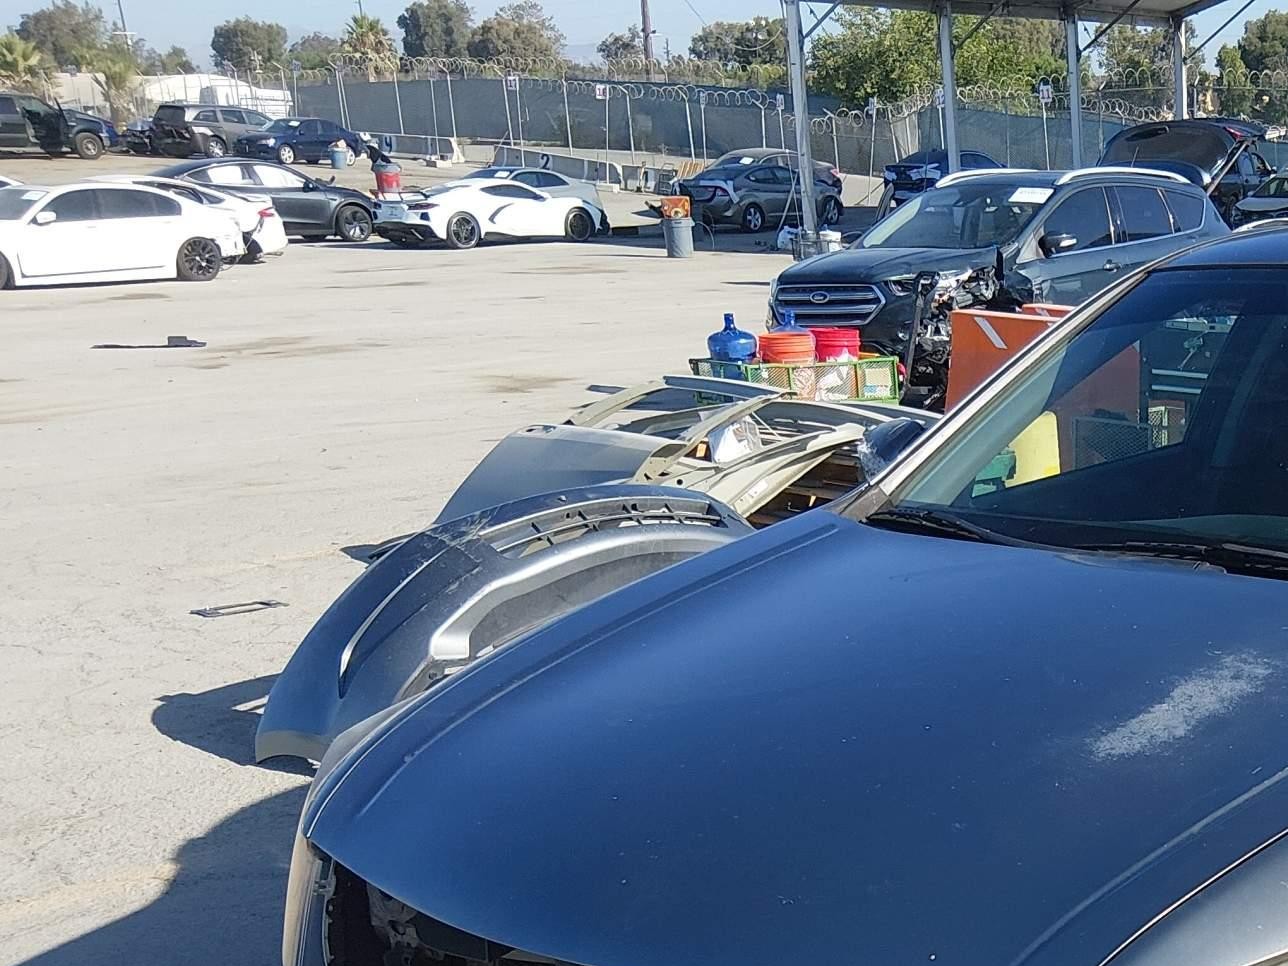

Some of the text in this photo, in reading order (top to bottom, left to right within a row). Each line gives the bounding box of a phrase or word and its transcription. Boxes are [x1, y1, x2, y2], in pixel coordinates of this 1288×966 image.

[1040, 88, 1051, 99] 11
[384, 135, 393, 153] 4
[540, 153, 550, 169] 2
